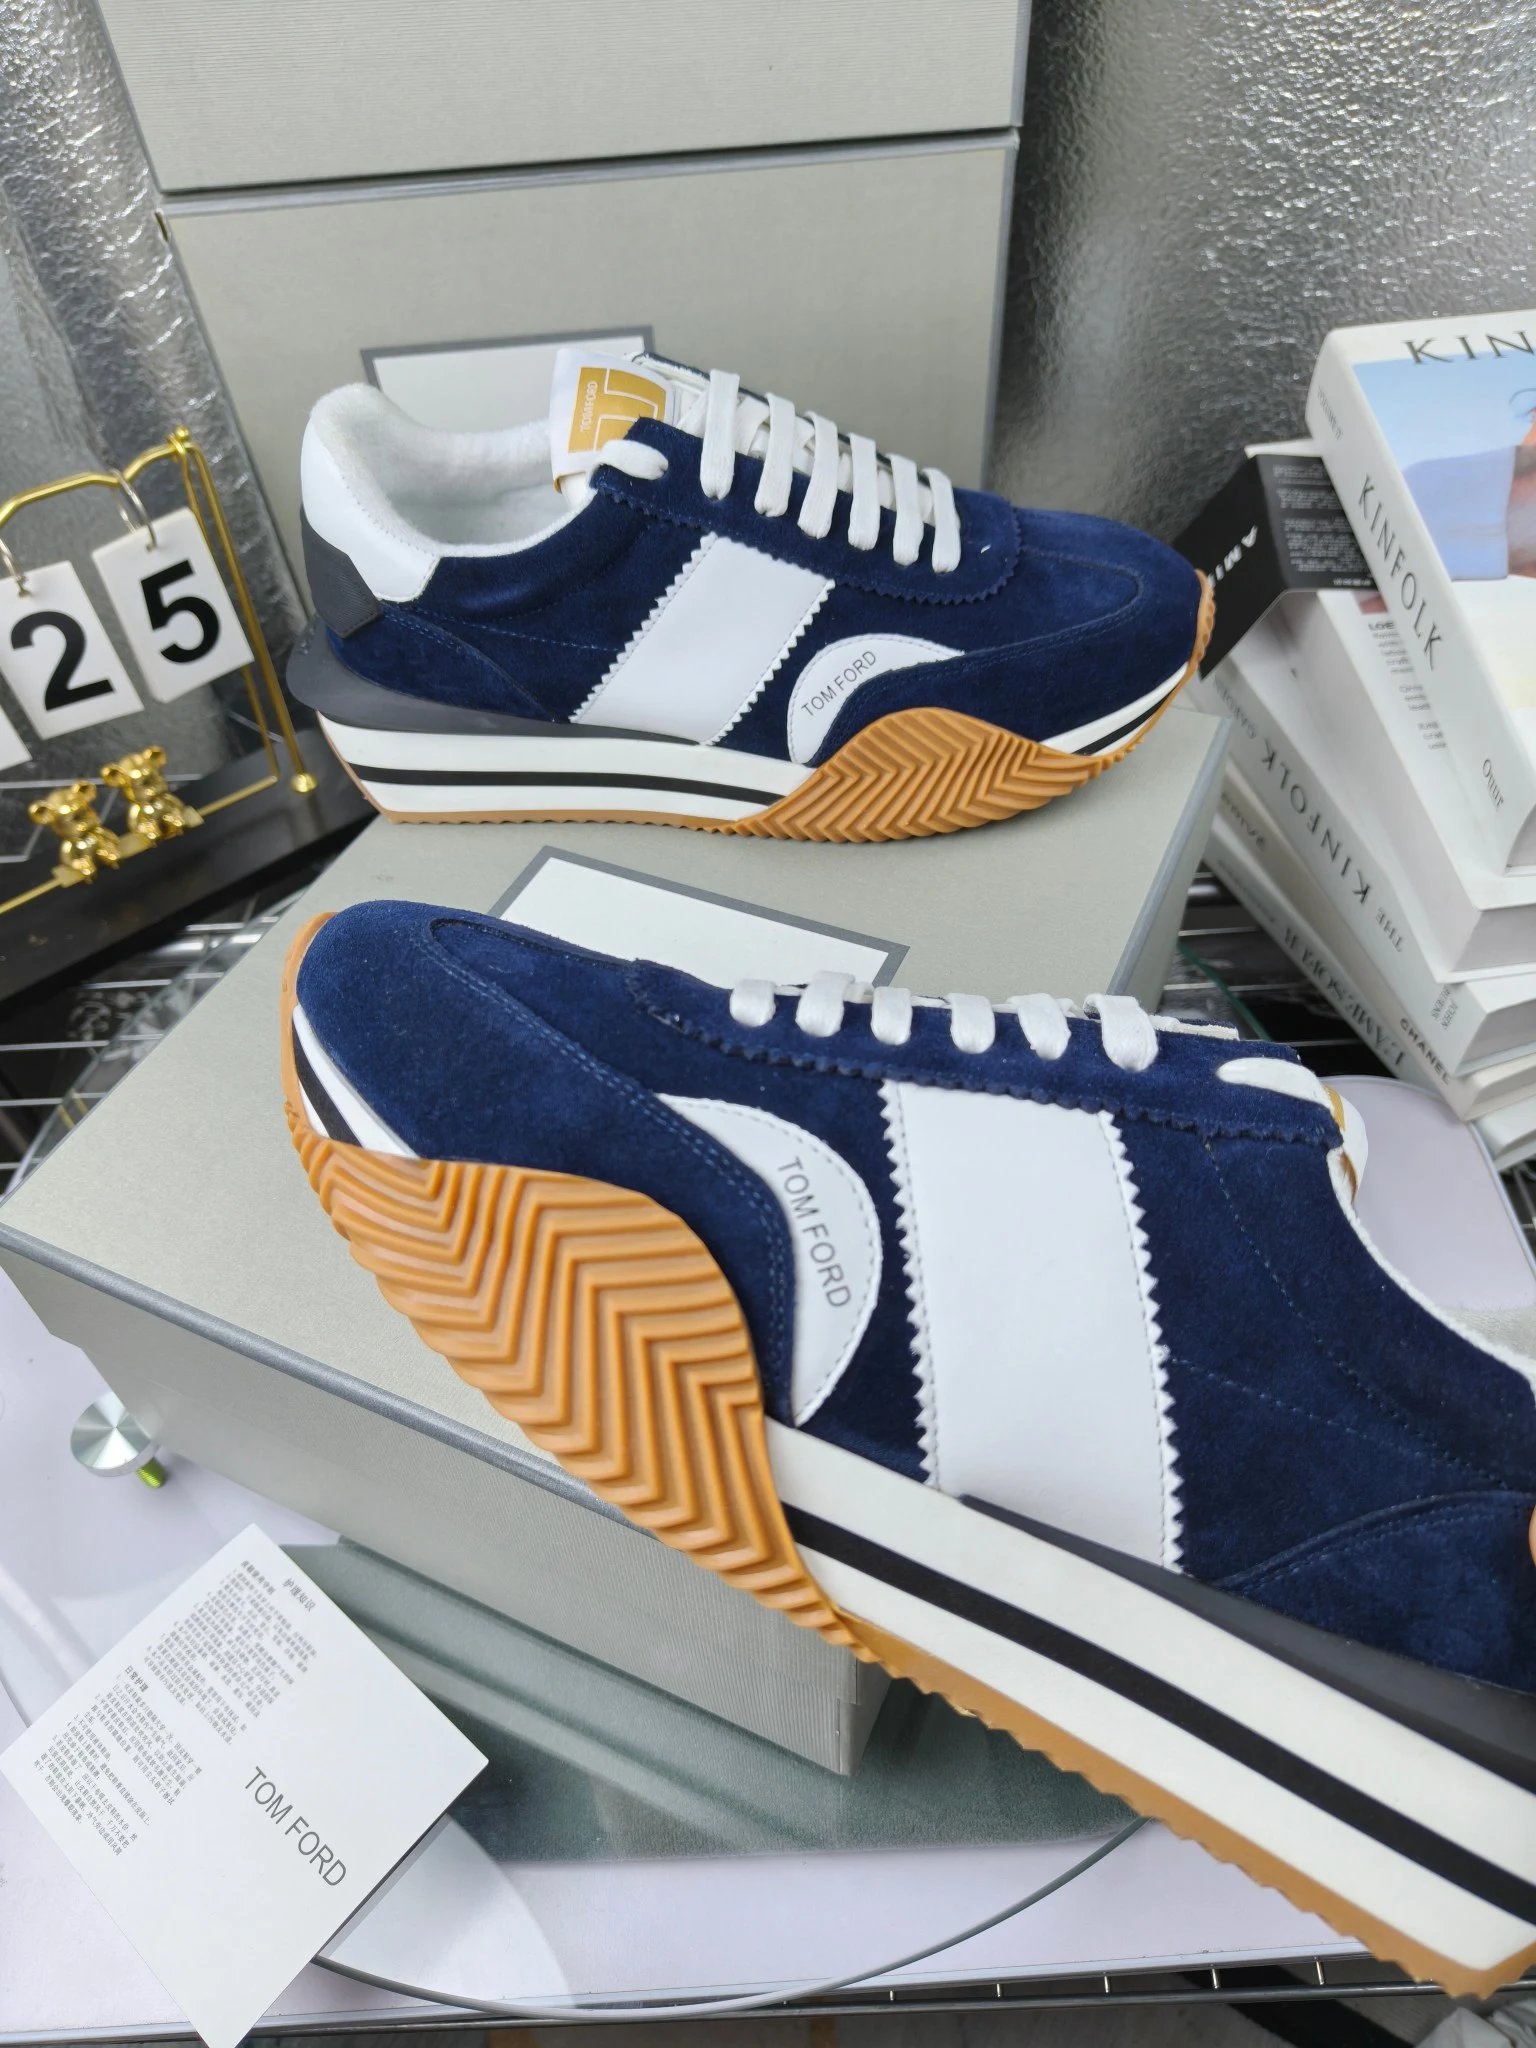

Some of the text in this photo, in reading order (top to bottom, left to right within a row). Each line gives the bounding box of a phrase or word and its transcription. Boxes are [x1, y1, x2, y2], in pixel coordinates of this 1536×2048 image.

[1405, 331, 1536, 365] KIN
[1358, 473, 1444, 671] KINFOLK
[10, 559, 221, 712] 2 5
[801, 651, 877, 717] TOM FORD
[1261, 737, 1372, 905] KINFOLK
[1376, 905, 1404, 954] THE
[1400, 1018, 1451, 1086] CHANEL
[778, 1156, 852, 1307] TOM FORD
[281, 1576, 317, 1613] 护理知识
[124, 1665, 149, 1693] 日常护理
[244, 1766, 347, 1887] TOM FORD
